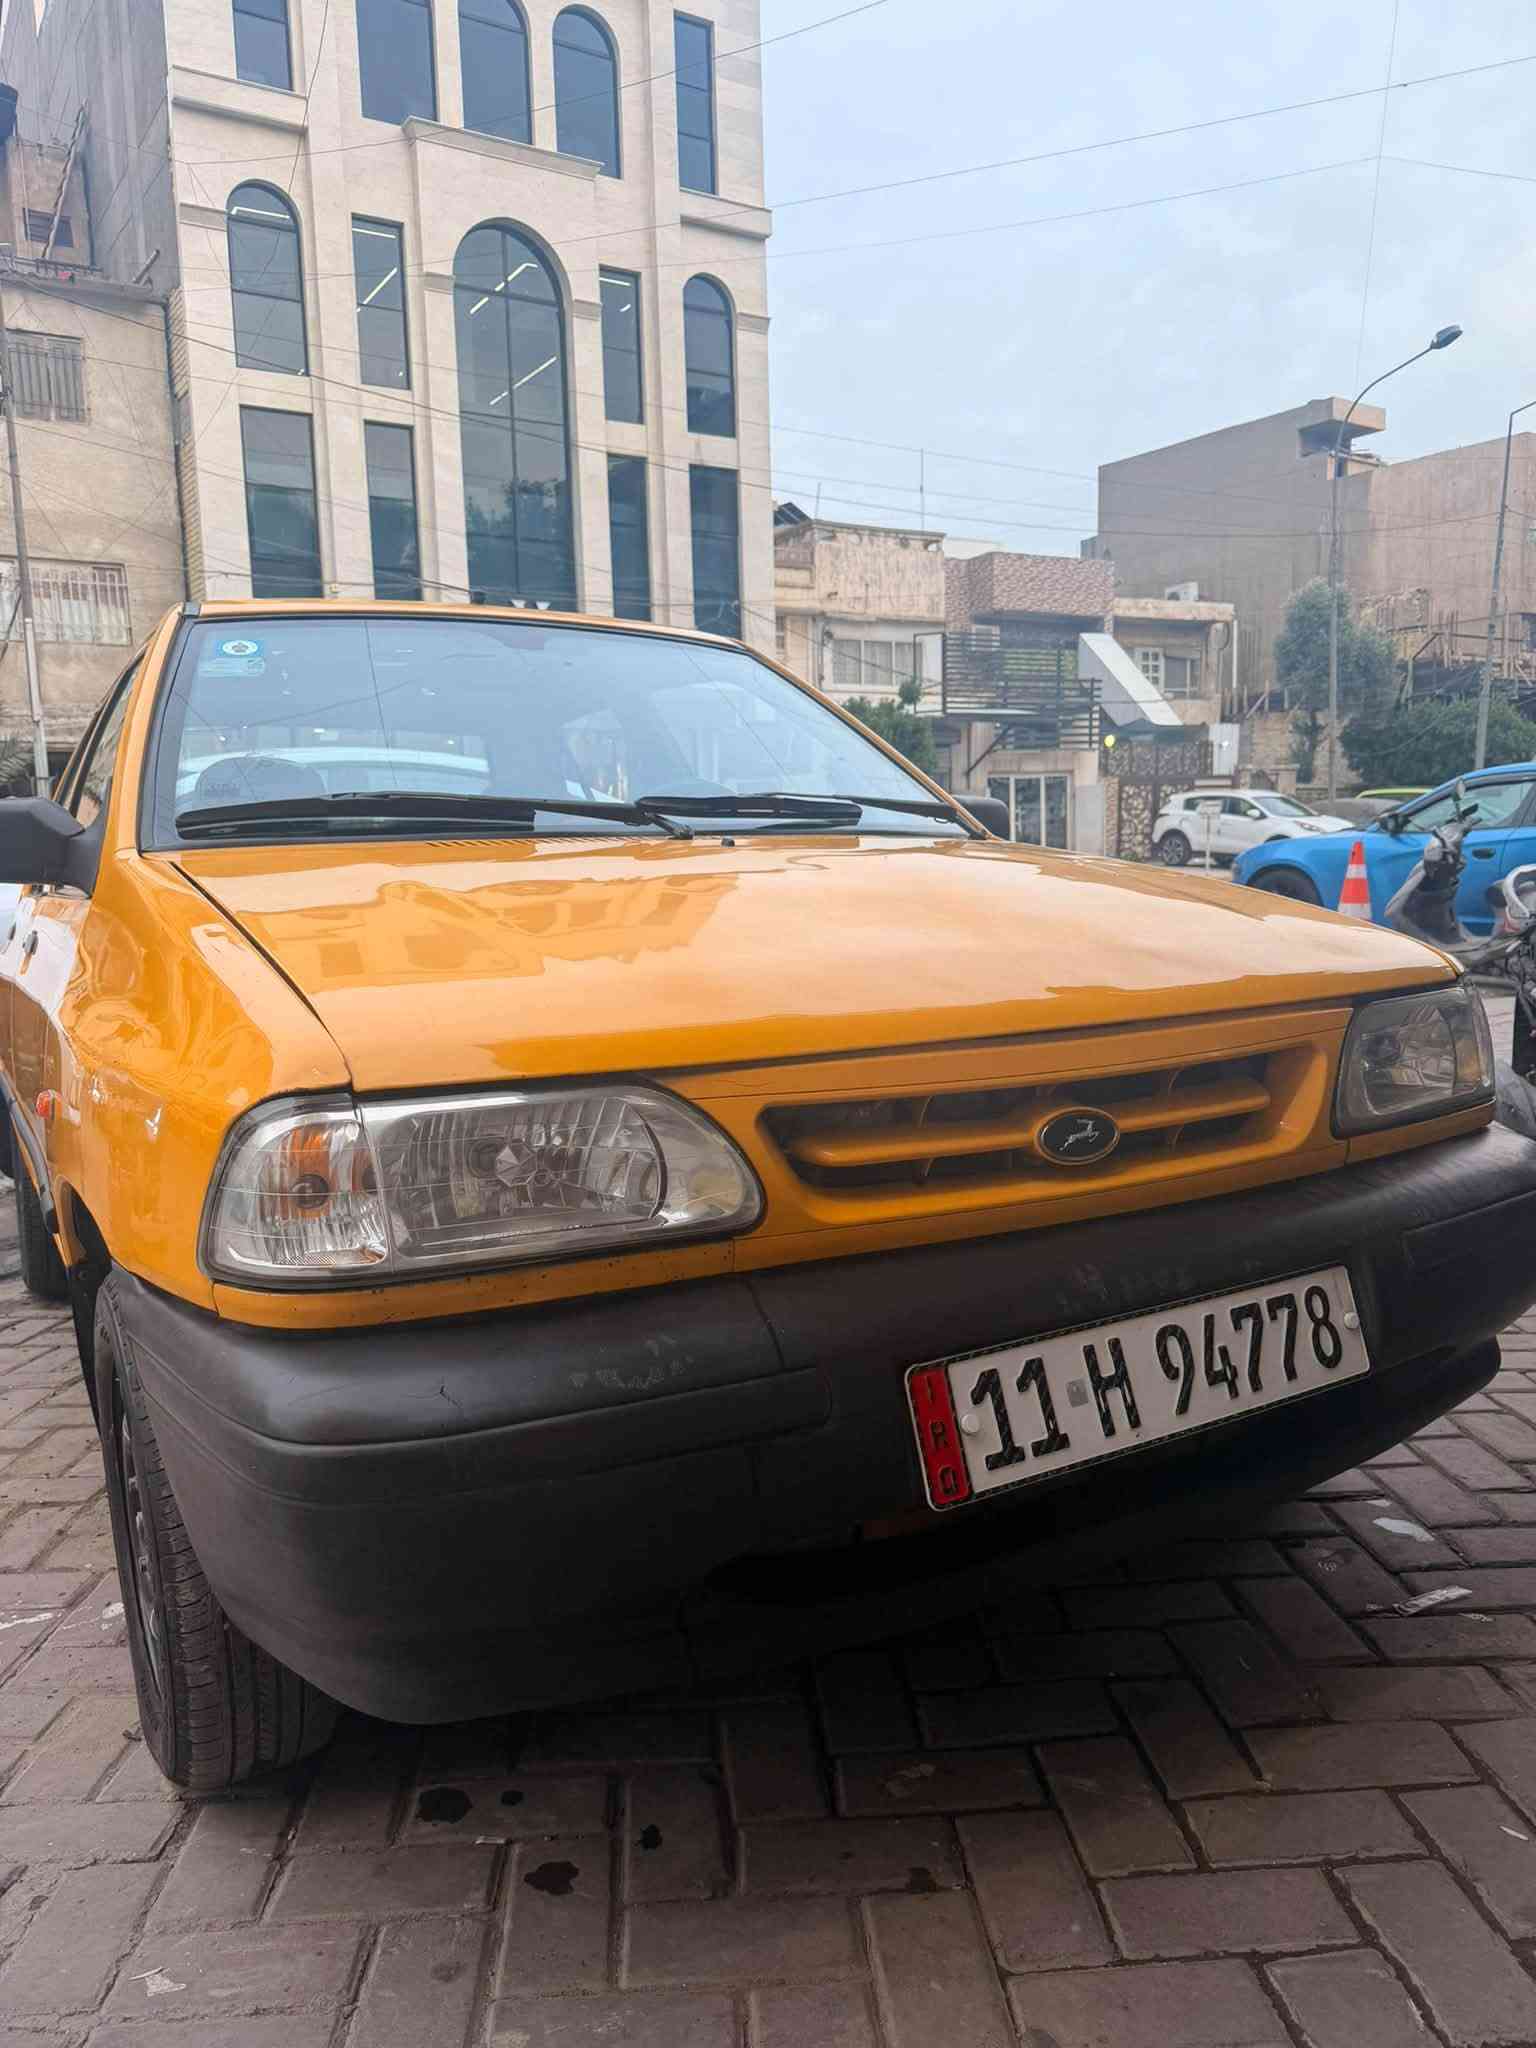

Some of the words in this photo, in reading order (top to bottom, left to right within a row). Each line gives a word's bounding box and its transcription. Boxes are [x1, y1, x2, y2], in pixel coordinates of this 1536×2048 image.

[971, 1357, 1071, 1471] 11
[1083, 1337, 1140, 1437] H
[1155, 1285, 1343, 1416] 94778
